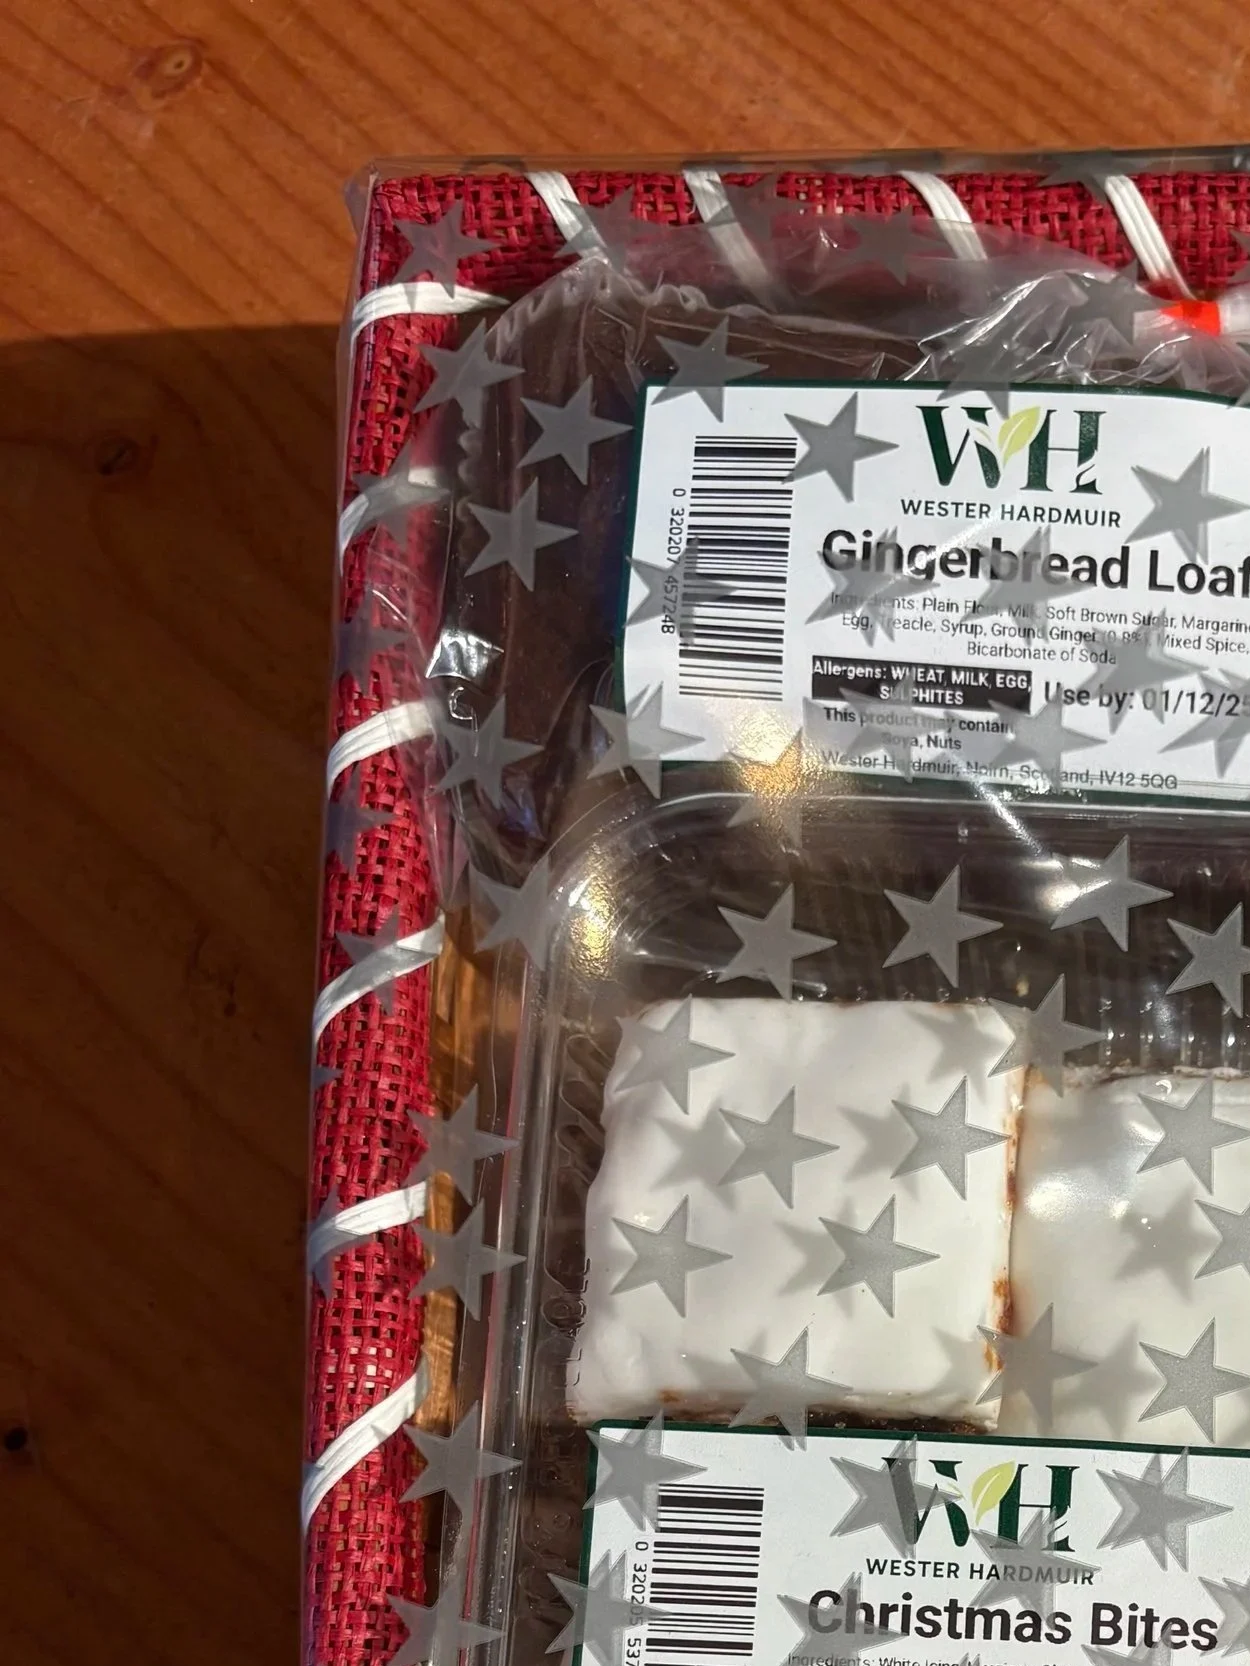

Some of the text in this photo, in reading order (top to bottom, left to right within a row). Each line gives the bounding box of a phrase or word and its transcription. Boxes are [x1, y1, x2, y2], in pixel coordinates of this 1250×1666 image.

[916, 406, 1107, 495] WH
[900, 499, 1122, 529] WESTER HARDMUIR
[661, 488, 686, 635] 0 320207 457248
[822, 529, 1131, 590] Gingerbread
[923, 597, 959, 614] Plain
[1046, 606, 1075, 621] Soft
[1080, 608, 1127, 625] Brown
[1132, 611, 1177, 629] Sugar,
[842, 613, 873, 630] Egg,
[991, 622, 1047, 640] Ground
[1157, 633, 1201, 650] Mixed
[967, 640, 1117, 665] Bicarbonate of Soda
[812, 660, 887, 681] Allergens:
[951, 671, 992, 689] MILK,
[996, 673, 1032, 691] EGG,
[1044, 680, 1090, 706] Use
[1099, 683, 1135, 714] by:
[823, 707, 856, 723] This
[860, 710, 918, 729] product
[926, 734, 962, 750] Nuts
[883, 755, 961, 776] Hdmuir,
[1099, 770, 1135, 786] IV12
[1139, 773, 1178, 790] 5QG
[881, 1456, 1081, 1553] WH
[865, 1557, 1095, 1586] WESTER HARDMUIR
[629, 1563, 648, 1626] 320205
[807, 1589, 1220, 1652] Christmas Bites
